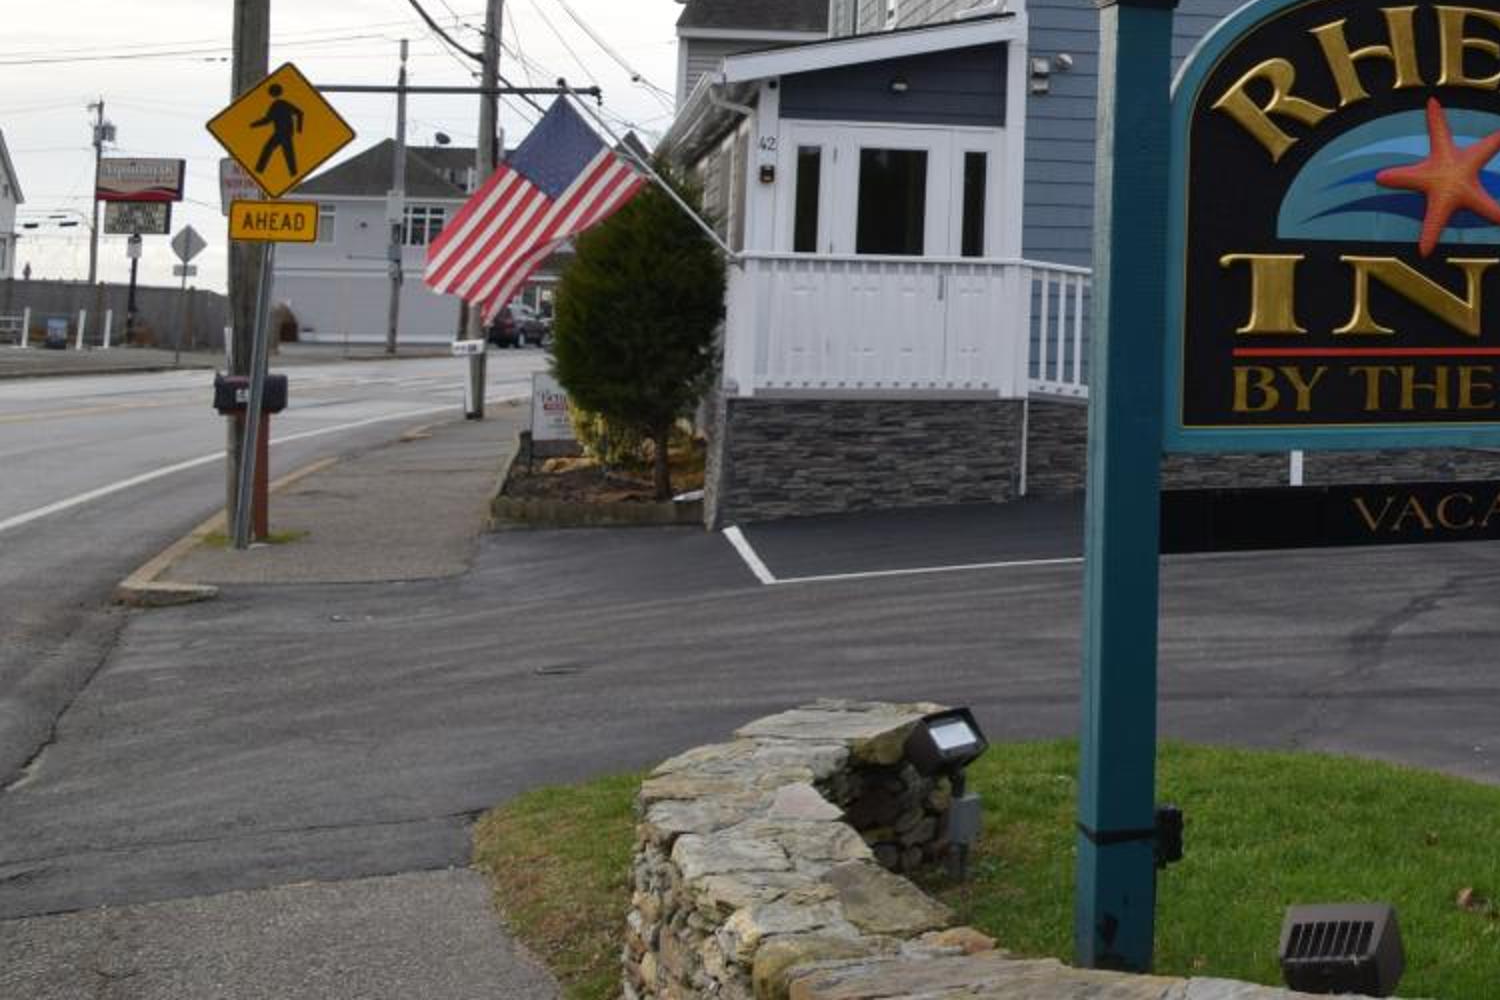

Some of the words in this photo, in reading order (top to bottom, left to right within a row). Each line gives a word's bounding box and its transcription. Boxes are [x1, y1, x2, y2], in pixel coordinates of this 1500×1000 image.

[757, 135, 776, 151] 42
[242, 211, 305, 232] AHEAD
[1232, 365, 1328, 413] BY
[1350, 364, 1497, 411] THE
